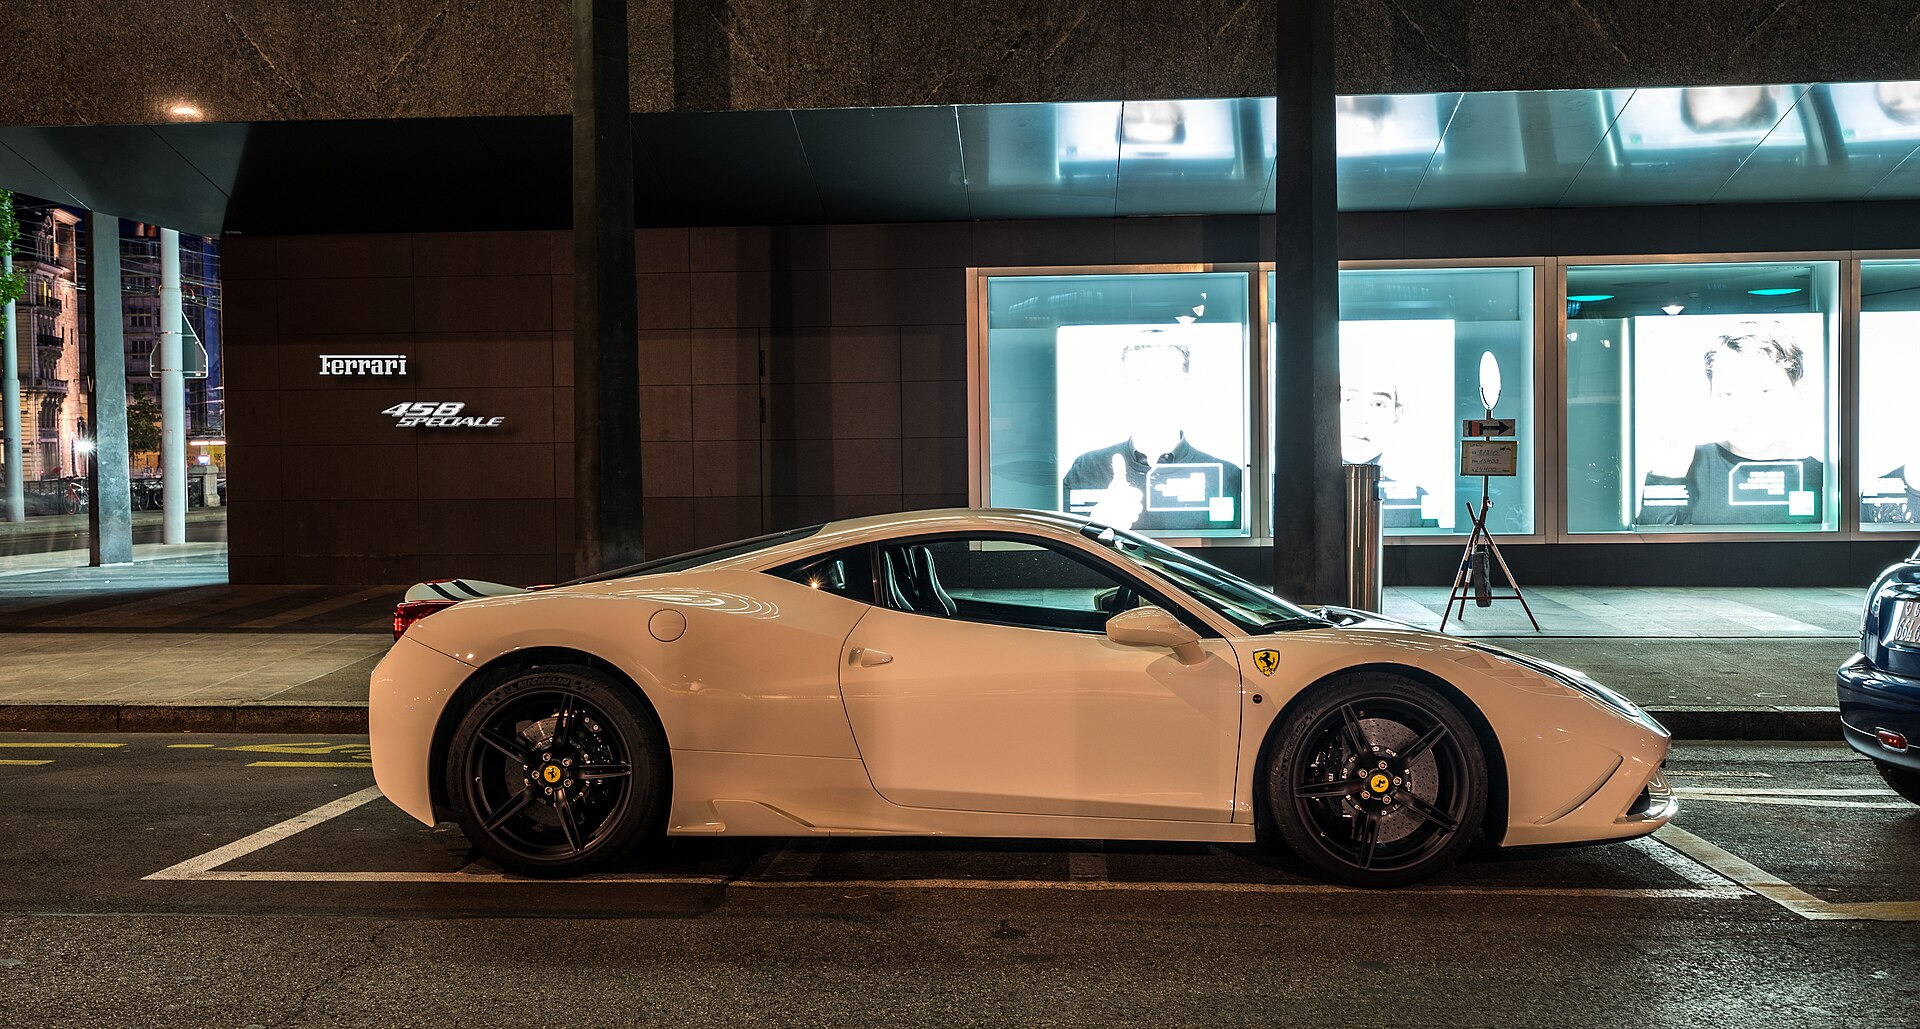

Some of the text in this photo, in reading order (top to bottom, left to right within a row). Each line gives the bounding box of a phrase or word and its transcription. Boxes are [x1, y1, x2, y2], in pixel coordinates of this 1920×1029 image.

[1896, 618, 1914, 641] 664
[517, 677, 571, 688] MICHELIN
[1284, 722, 1306, 760] MICHELIN
